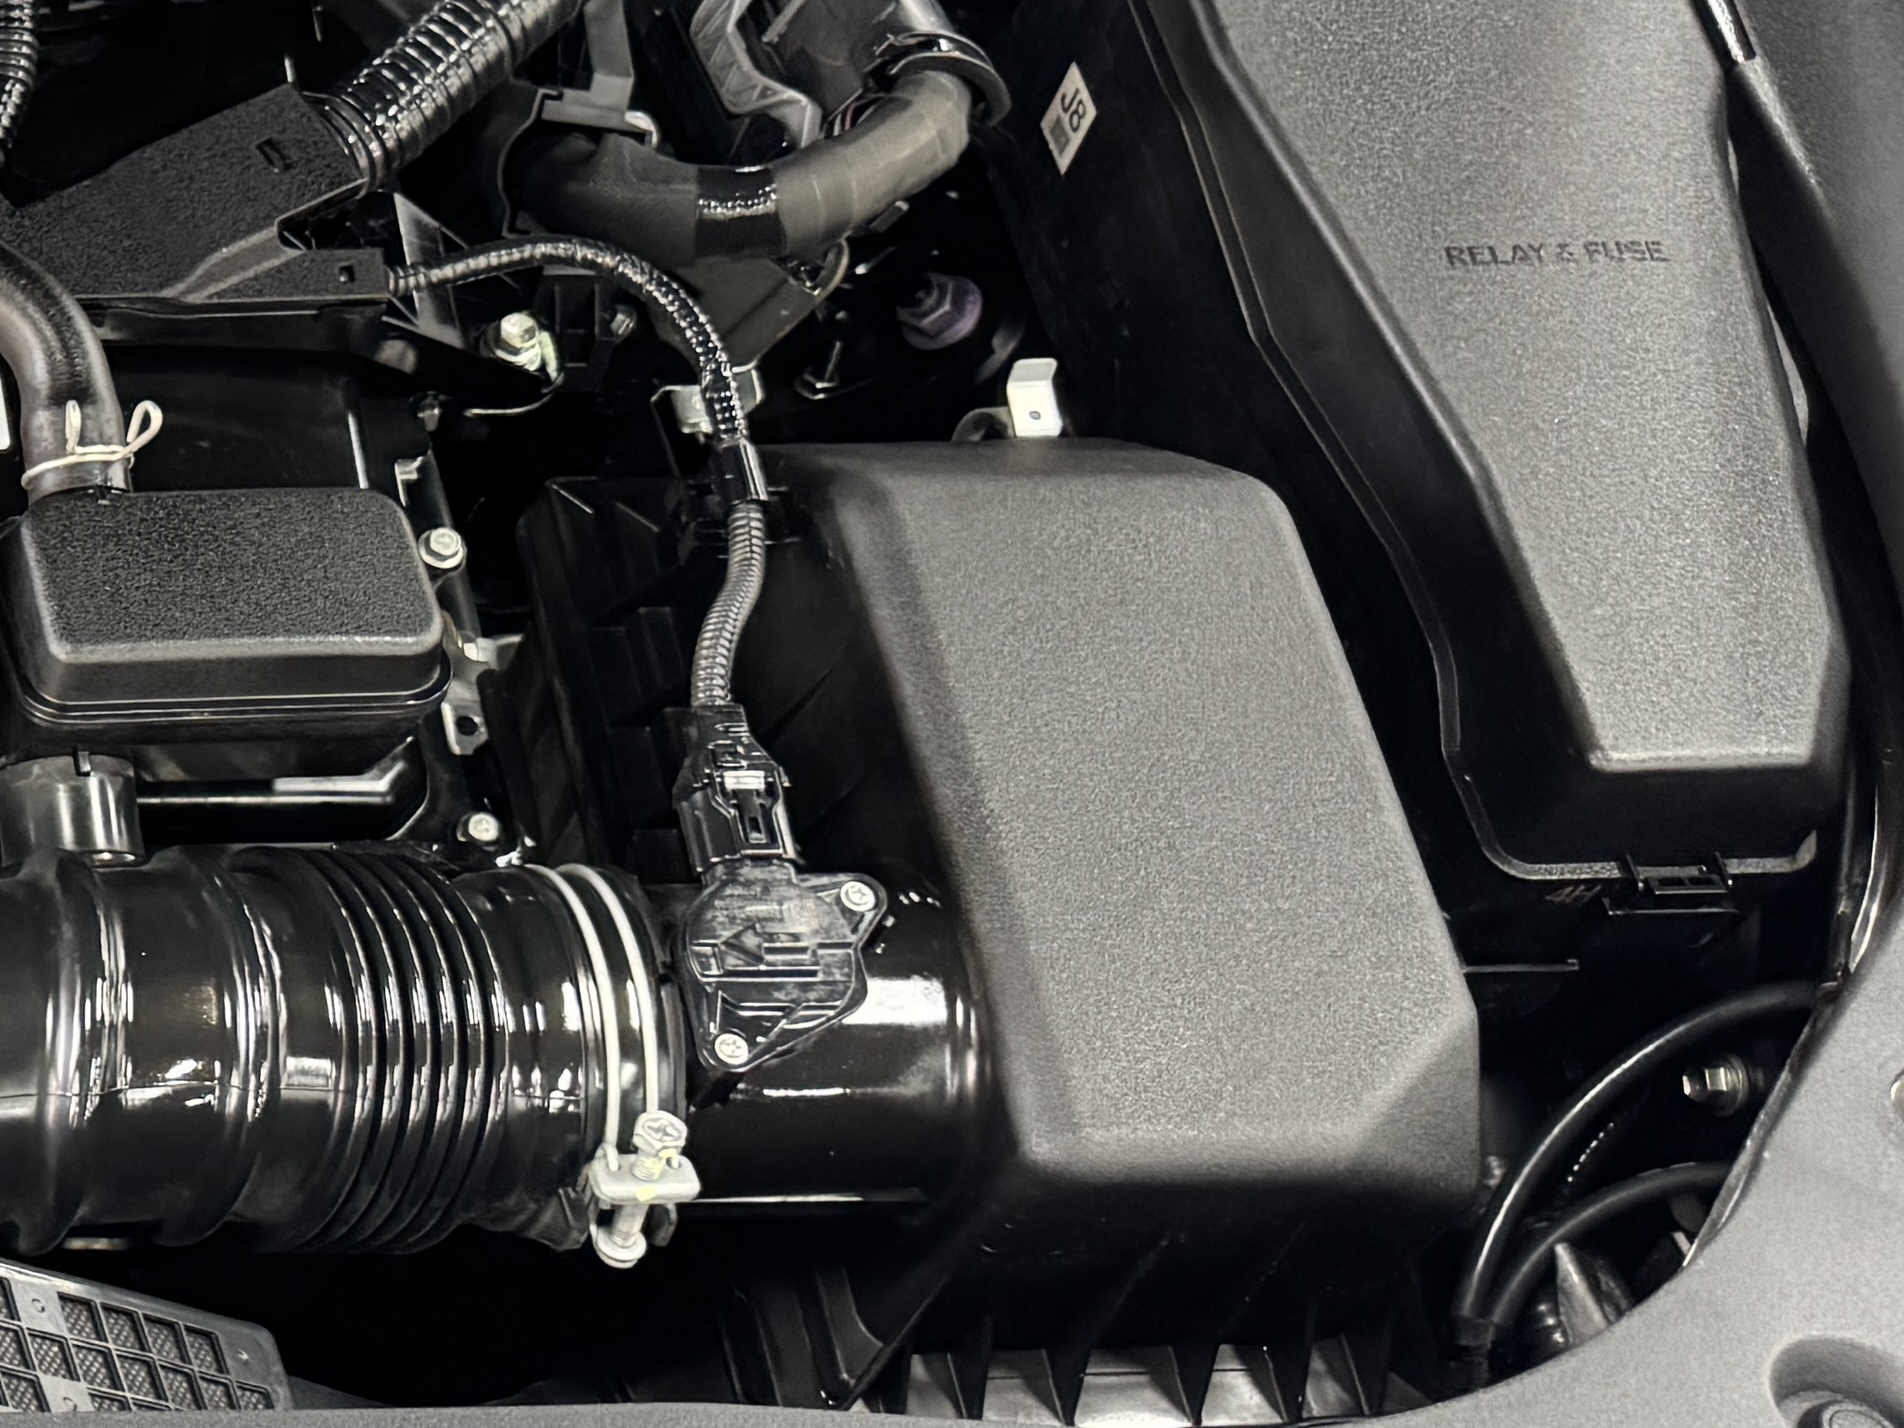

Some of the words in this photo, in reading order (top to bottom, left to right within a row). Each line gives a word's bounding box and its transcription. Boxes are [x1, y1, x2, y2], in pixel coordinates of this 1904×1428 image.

[1060, 86, 1087, 134] J8
[1444, 243, 1543, 267] RELAY
[1583, 239, 1671, 264] FUSE
